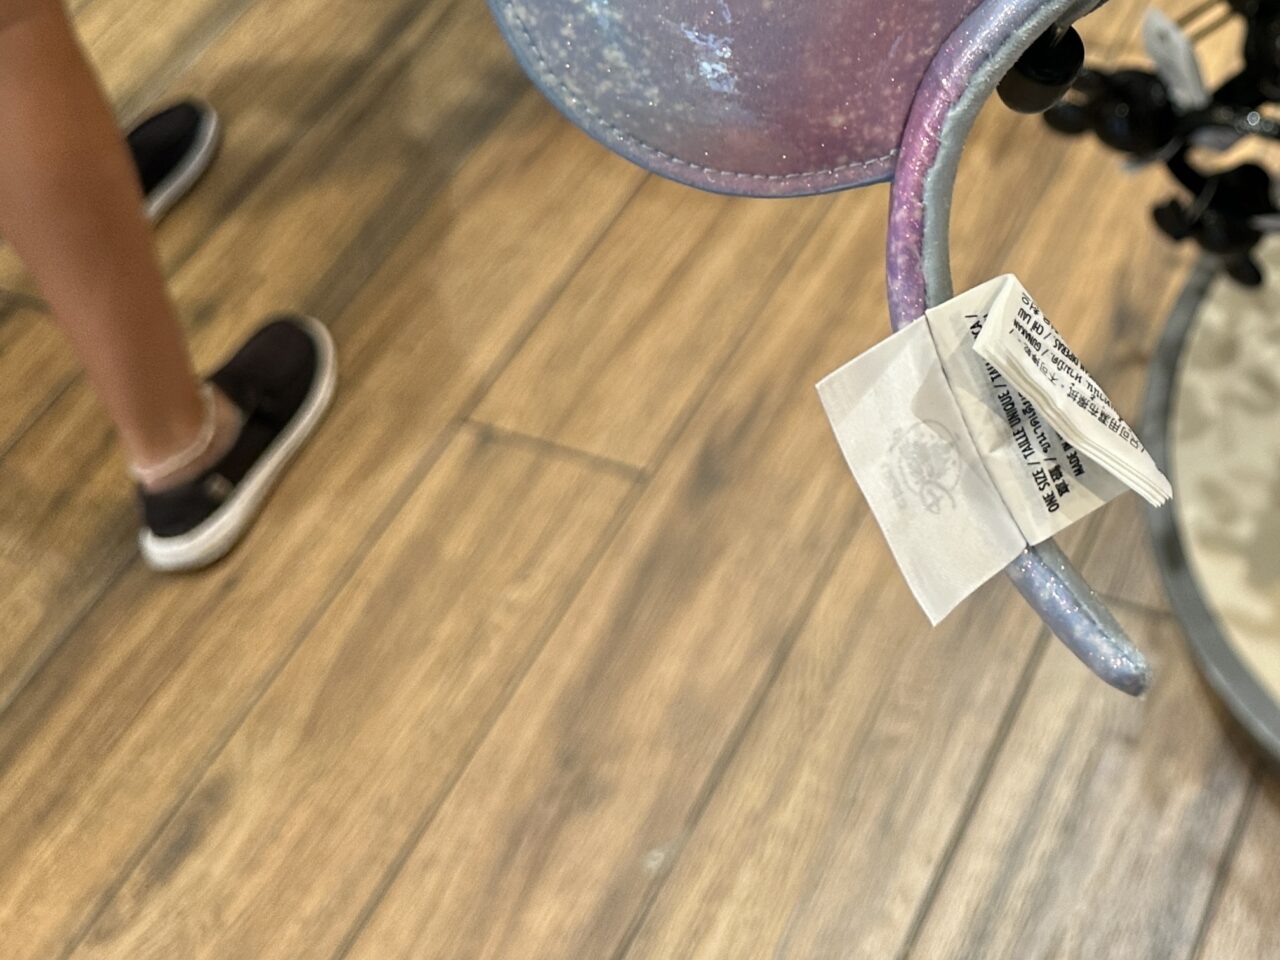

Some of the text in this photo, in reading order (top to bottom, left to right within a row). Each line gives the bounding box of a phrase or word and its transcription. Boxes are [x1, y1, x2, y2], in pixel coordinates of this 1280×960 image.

[997, 389, 1022, 429] UNIQUE
[1012, 426, 1035, 460] TAILLE
[1066, 450, 1085, 477] MADE
[1032, 467, 1051, 491] SIZE
[1042, 490, 1060, 513] ONE
